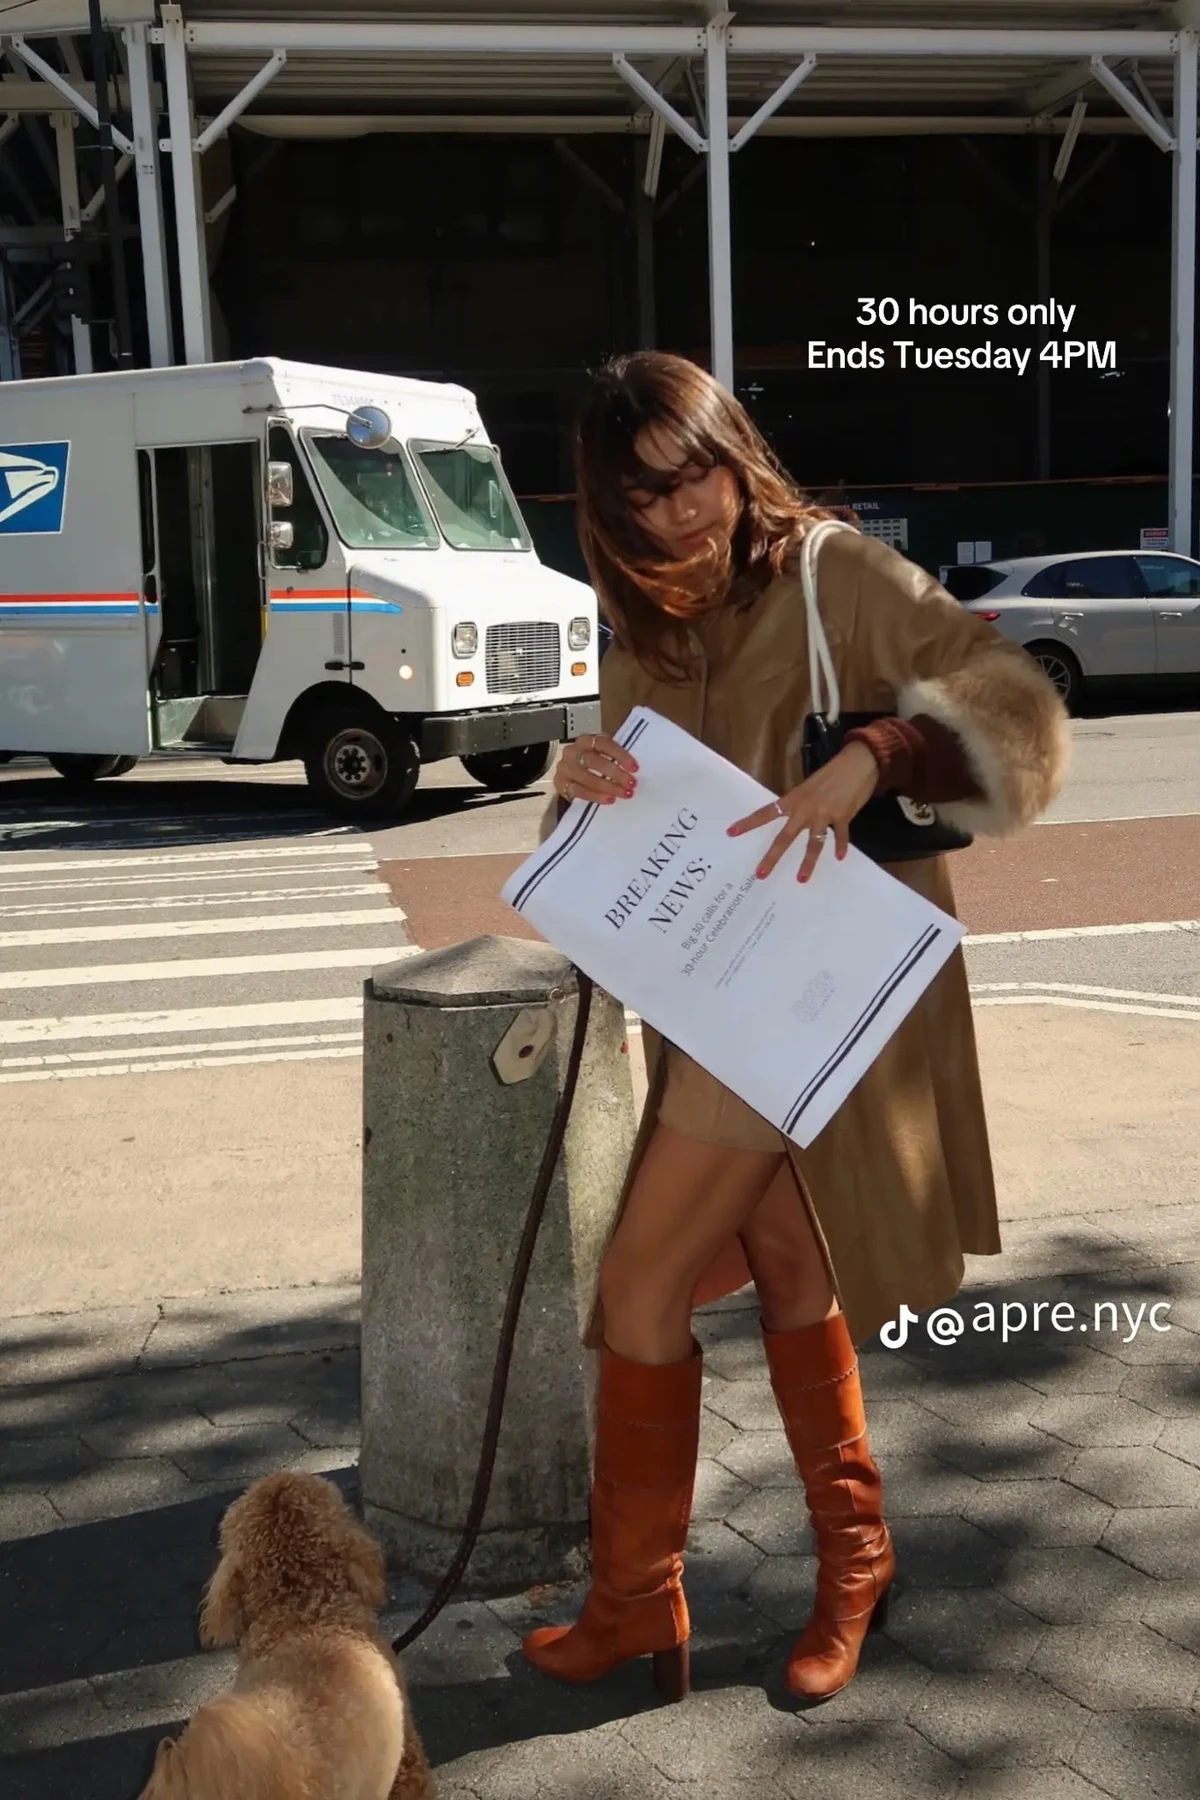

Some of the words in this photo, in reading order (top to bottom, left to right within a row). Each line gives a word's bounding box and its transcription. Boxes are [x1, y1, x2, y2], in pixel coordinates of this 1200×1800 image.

[852, 502, 880, 511] RETAIL
[603, 807, 698, 930] BREAKING
[647, 857, 712, 934] NEWS:
[681, 935, 698, 951] Big
[691, 922, 705, 936] 30
[701, 903, 719, 924] calls
[713, 889, 729, 904] for
[725, 882, 734, 890] a
[681, 943, 709, 977] 30-hour
[705, 893, 745, 943] Celebration
